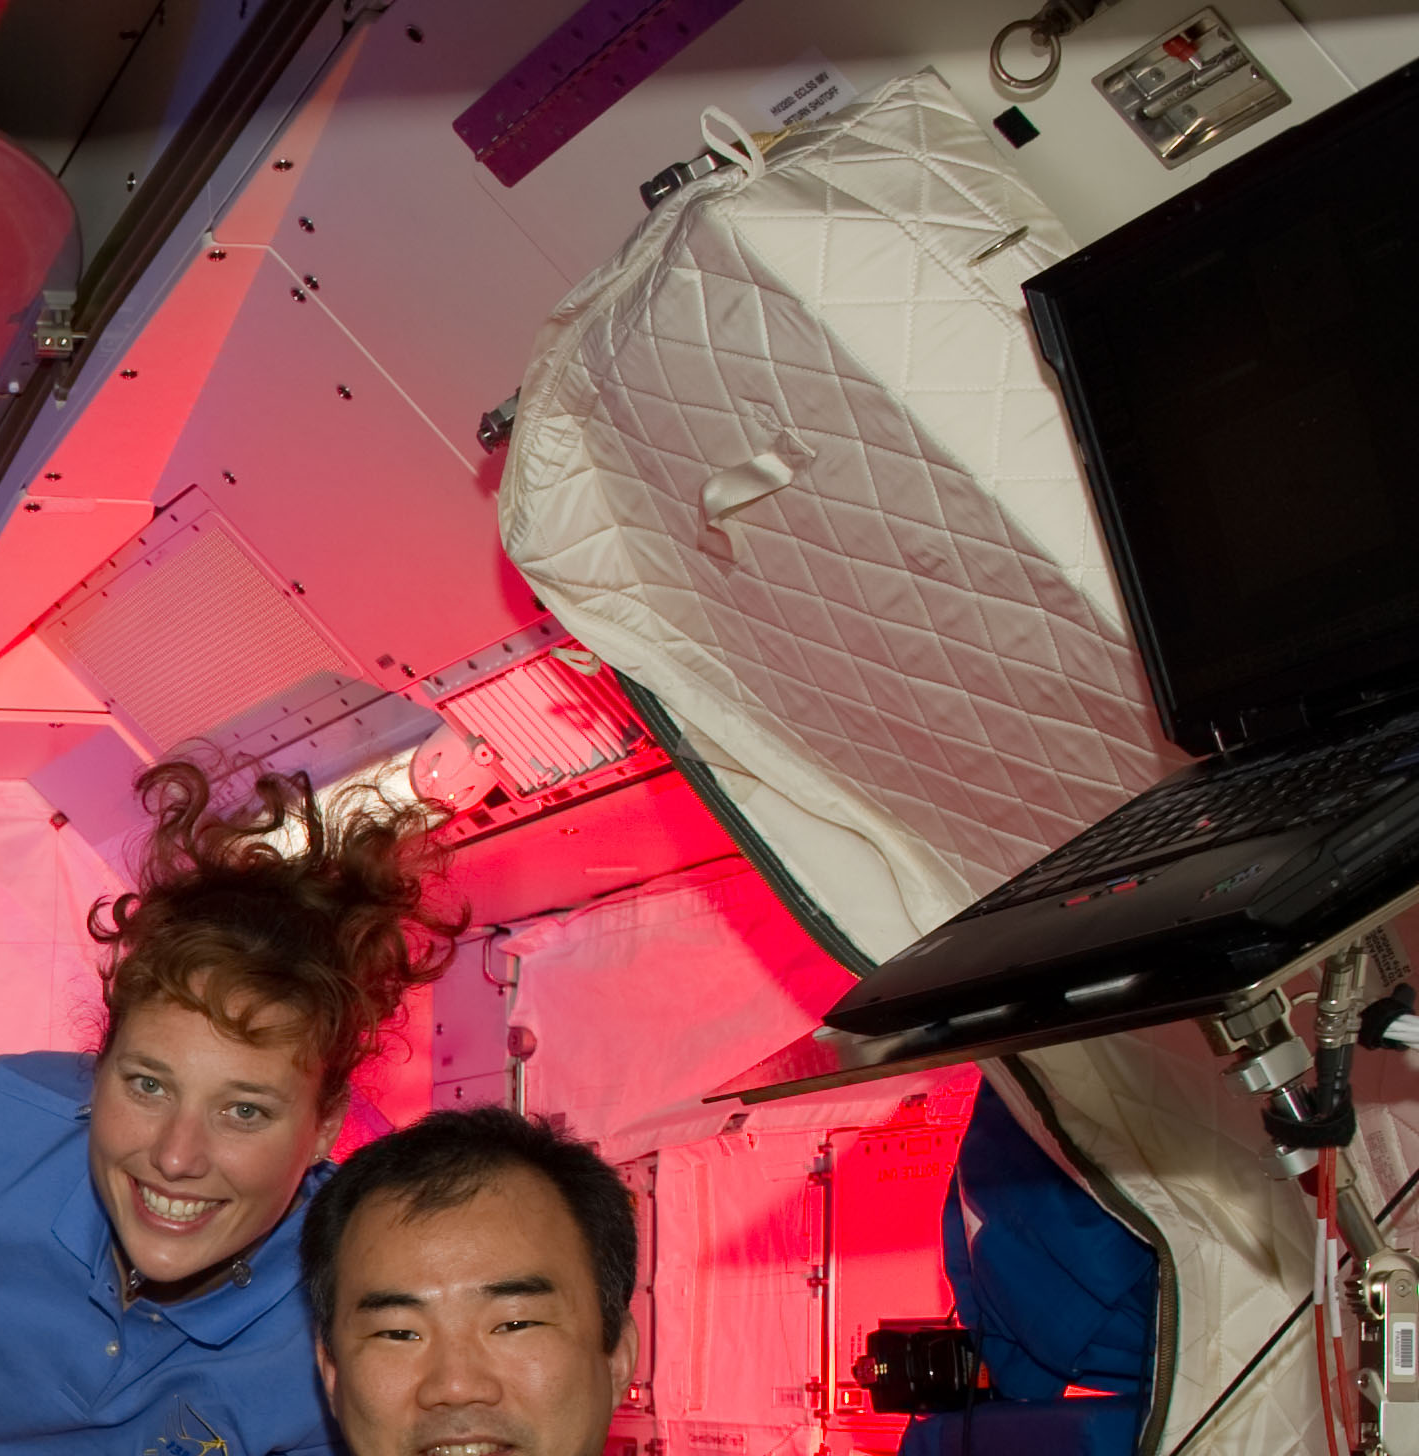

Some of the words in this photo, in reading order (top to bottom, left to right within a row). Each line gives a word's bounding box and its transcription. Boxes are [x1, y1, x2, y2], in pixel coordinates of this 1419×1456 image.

[792, 79, 817, 100] ECLSS
[808, 85, 839, 111] SHUTOFF
[901, 1162, 941, 1181] BOTTLE
